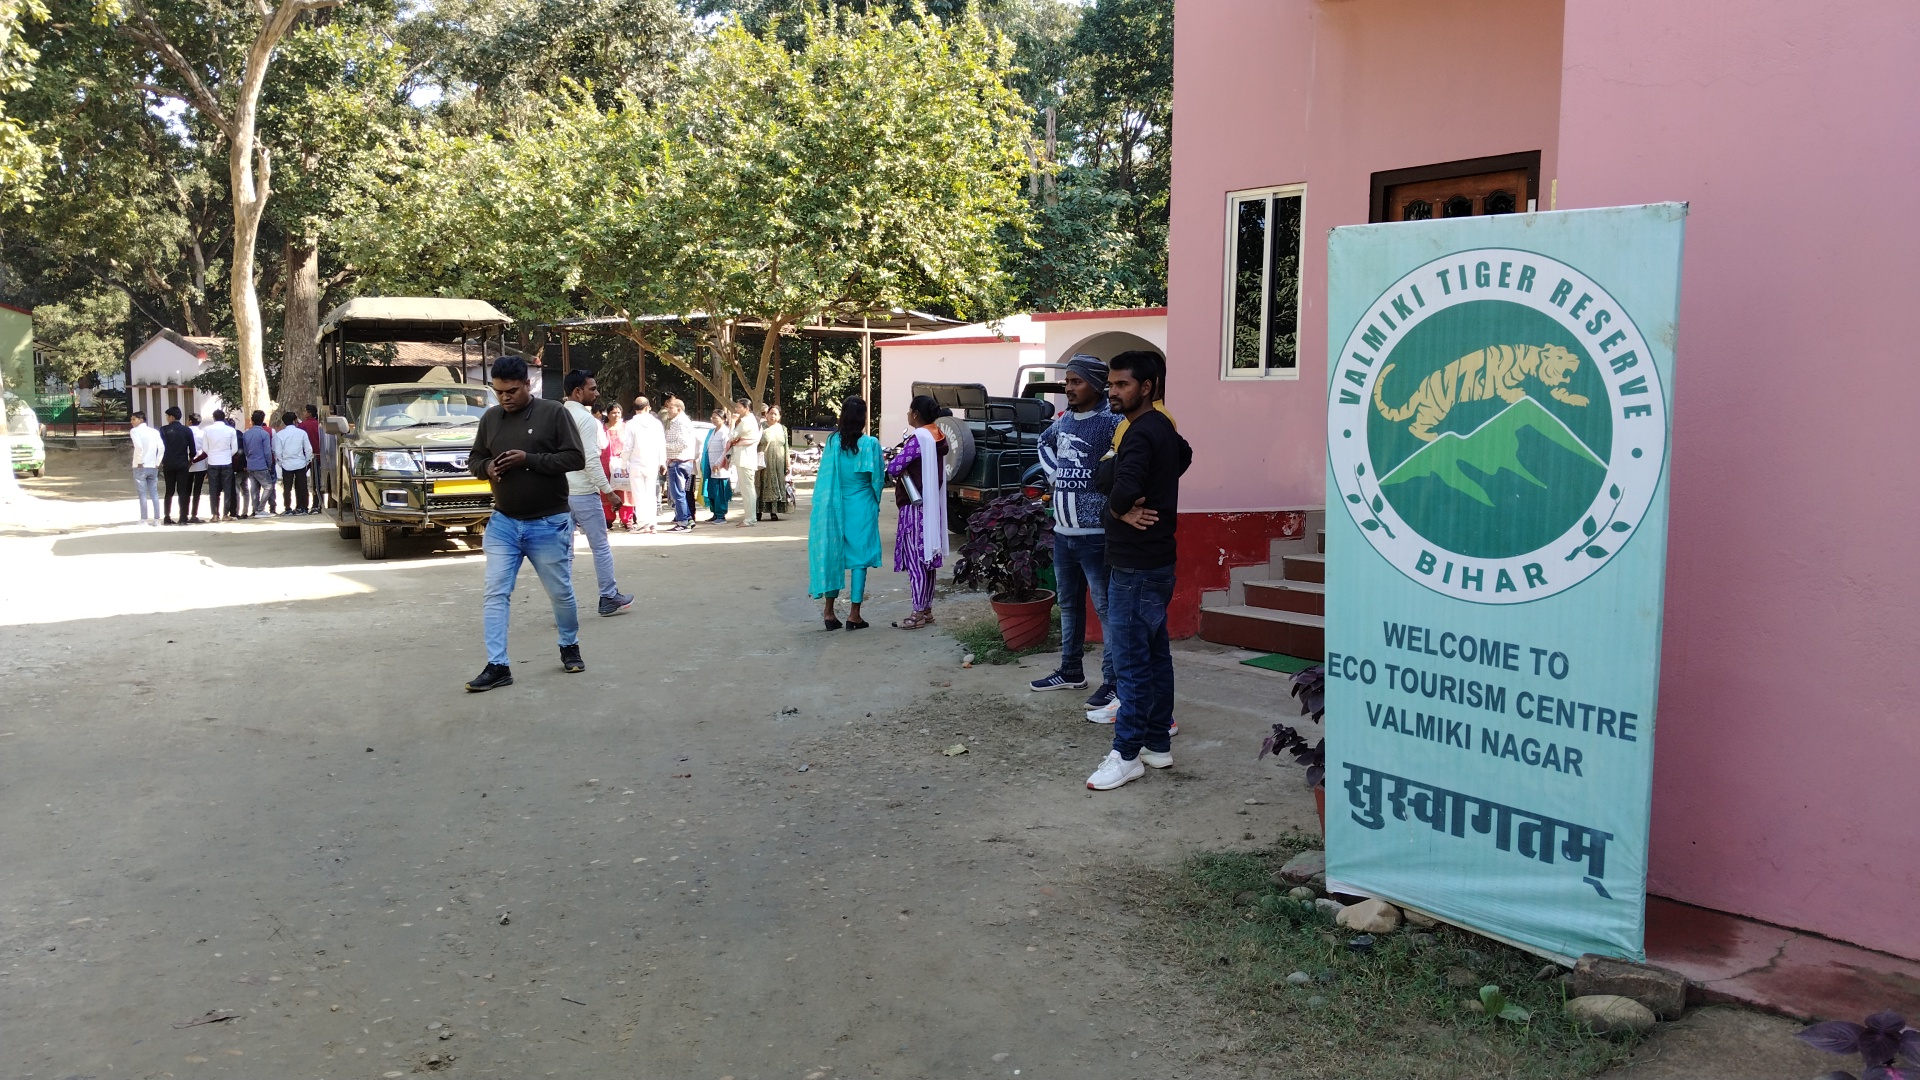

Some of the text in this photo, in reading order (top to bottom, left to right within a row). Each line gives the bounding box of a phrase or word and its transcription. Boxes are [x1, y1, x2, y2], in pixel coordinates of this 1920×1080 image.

[1338, 261, 1652, 420] VALMIKI TIGER RESERVE
[1057, 467, 1093, 479] BERR
[1415, 549, 1548, 593] BIHAR
[1383, 621, 1570, 680] WELCOME TO
[1328, 652, 1638, 743] ECO TOURISM CENTRE
[1366, 701, 1583, 778] VALMIKI NAGAR
[1342, 762, 1614, 900] सुस्वागतम्
